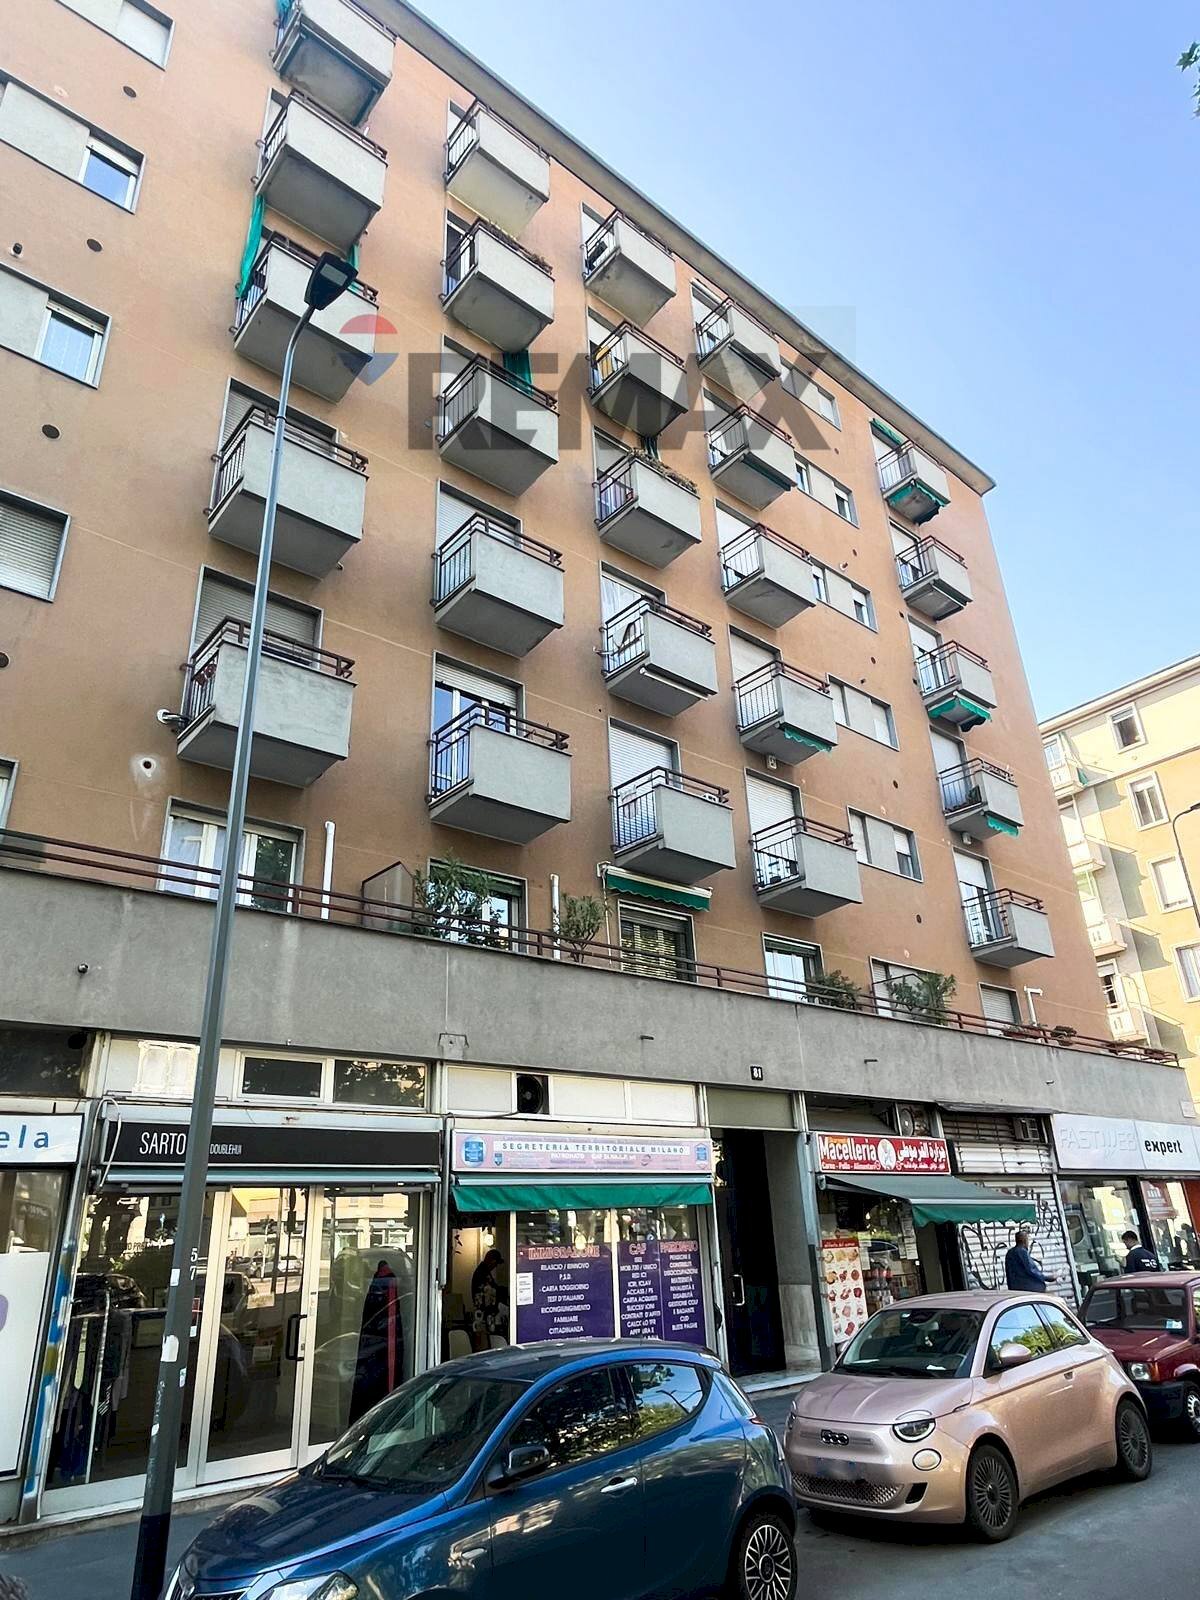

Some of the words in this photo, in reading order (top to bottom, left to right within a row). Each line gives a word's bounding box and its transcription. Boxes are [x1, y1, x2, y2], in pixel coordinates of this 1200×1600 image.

[753, 1067, 762, 1078] 81
[140, 1132, 187, 1156] SARTO
[502, 1142, 570, 1151] SEGRETERIA
[575, 1143, 646, 1153] TERRITORIALE
[651, 1146, 684, 1154] MILANO
[819, 1135, 876, 1161] Macelleria
[1144, 1139, 1183, 1155] expert
[559, 1283, 590, 1291] SOGGIORNO
